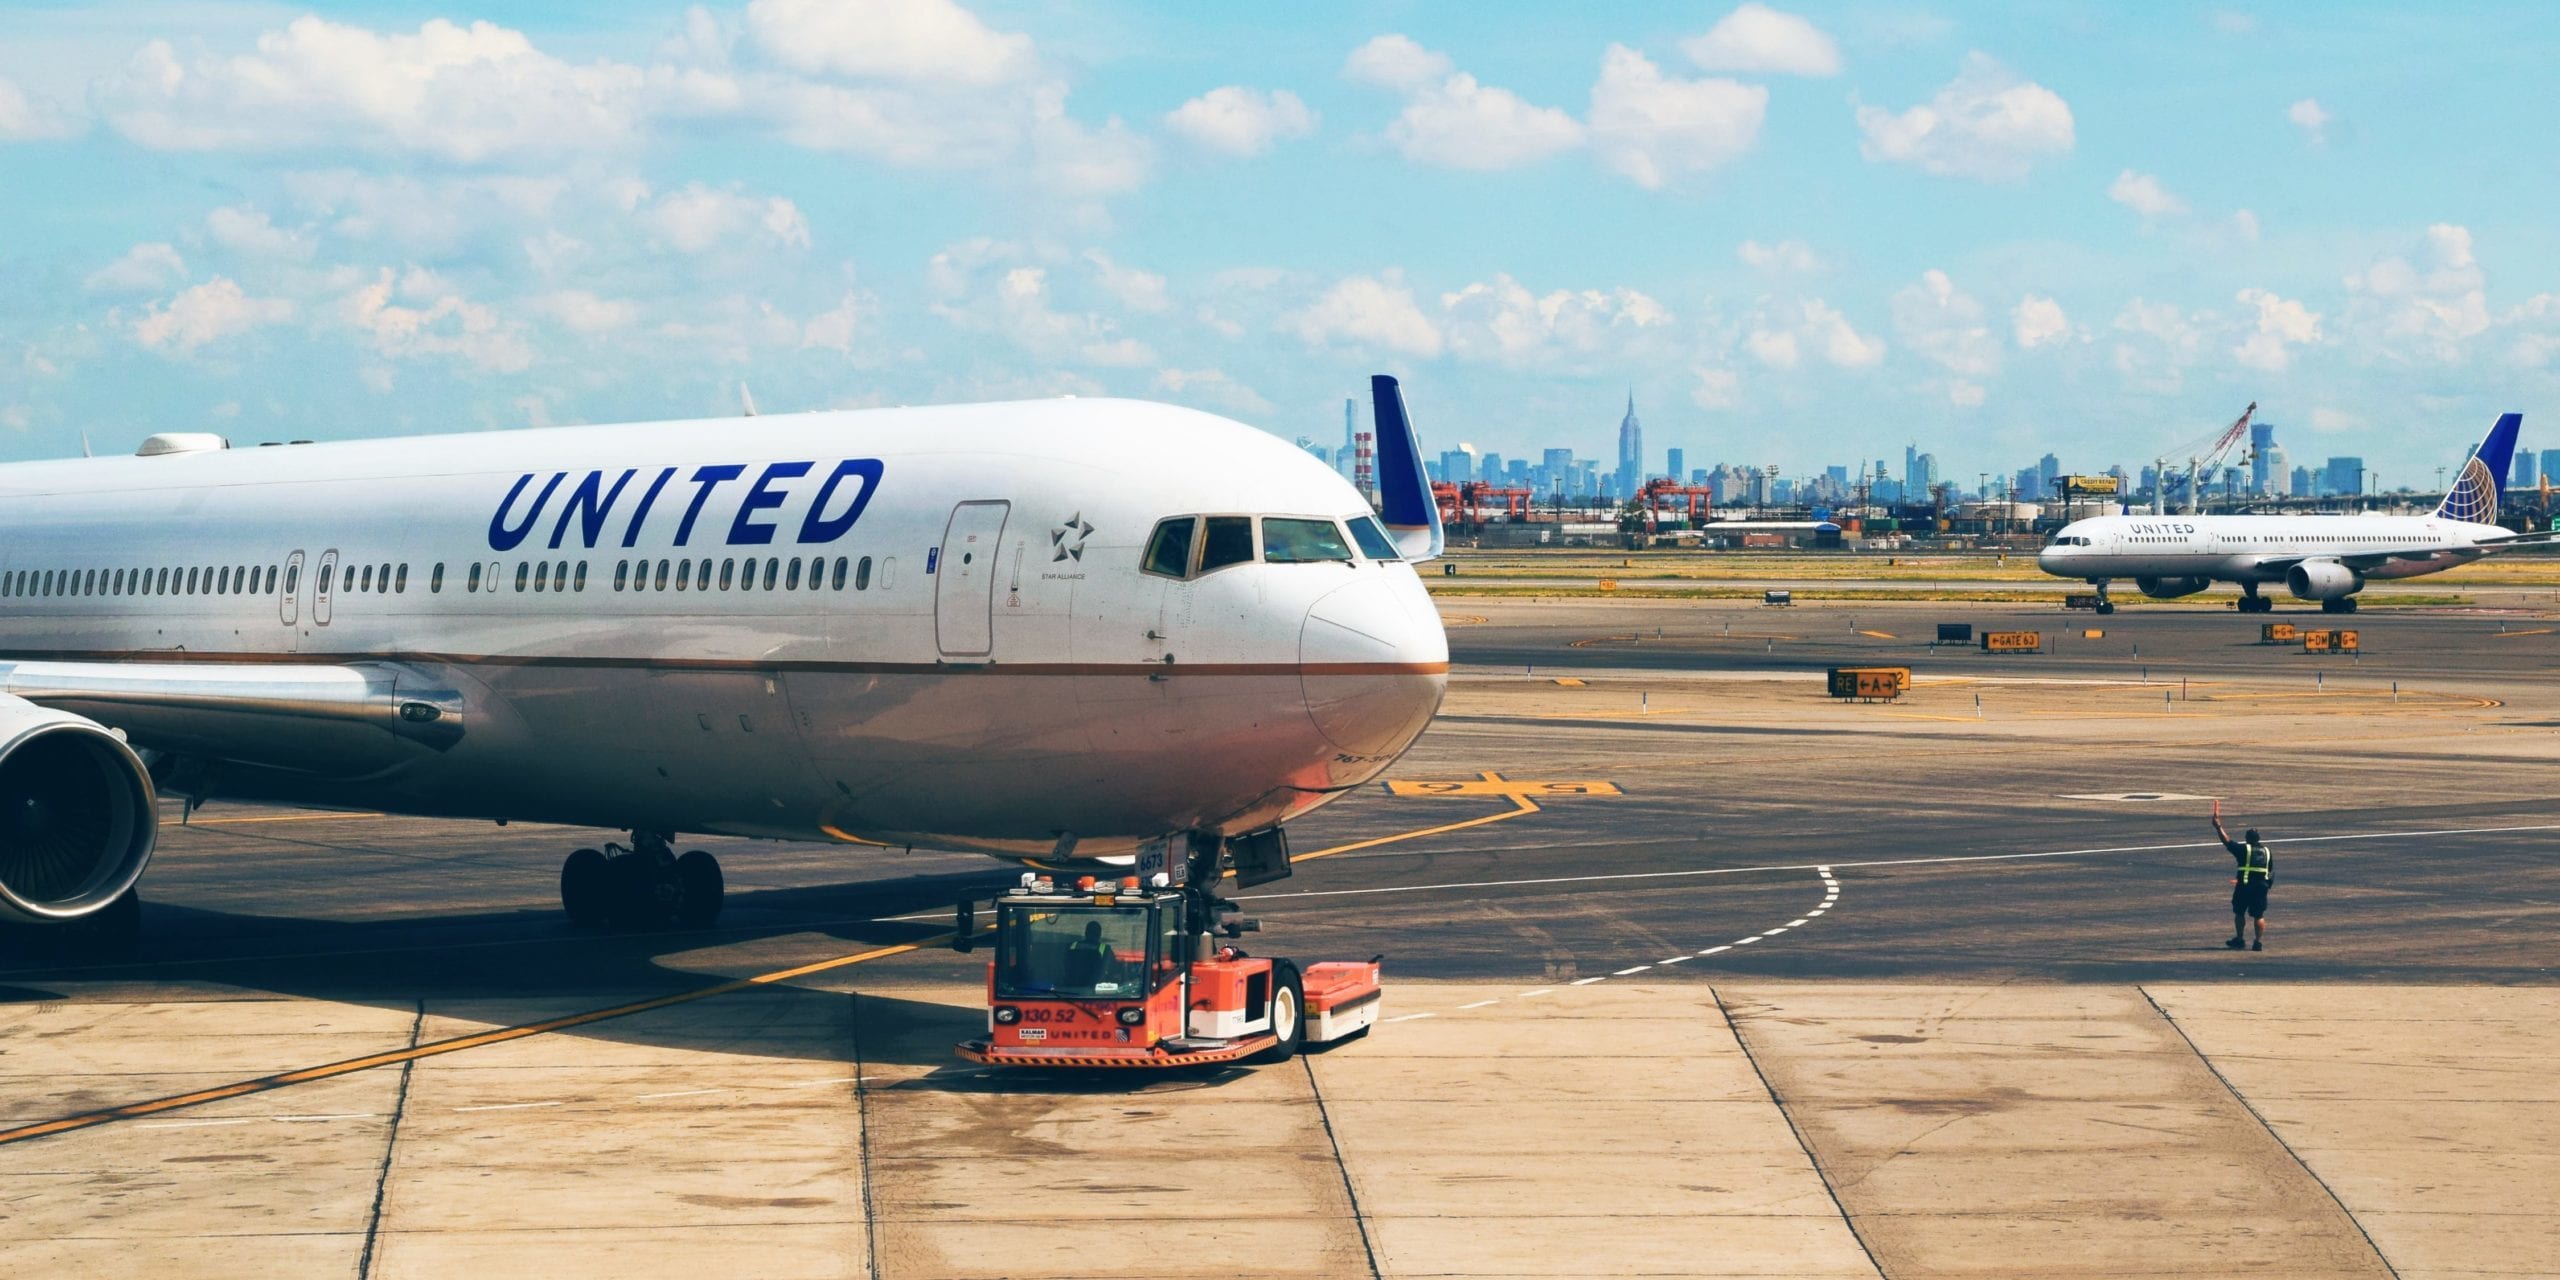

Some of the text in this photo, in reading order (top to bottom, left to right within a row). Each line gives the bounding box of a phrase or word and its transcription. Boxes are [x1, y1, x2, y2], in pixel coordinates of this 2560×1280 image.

[488, 458, 885, 551] UNITED
[2130, 524, 2195, 534] UNITED
[1449, 565, 1454, 574] 4
[2281, 627, 2286, 637] G
[2000, 635, 2035, 646] GATE 63
[2332, 635, 2338, 644] A
[2342, 634, 2349, 645] G
[1836, 676, 1881, 692] RE A
[1141, 853, 1163, 871] 6673
[1023, 1009, 1076, 1023] 130.52
[1050, 1030, 1111, 1039] UNITED
